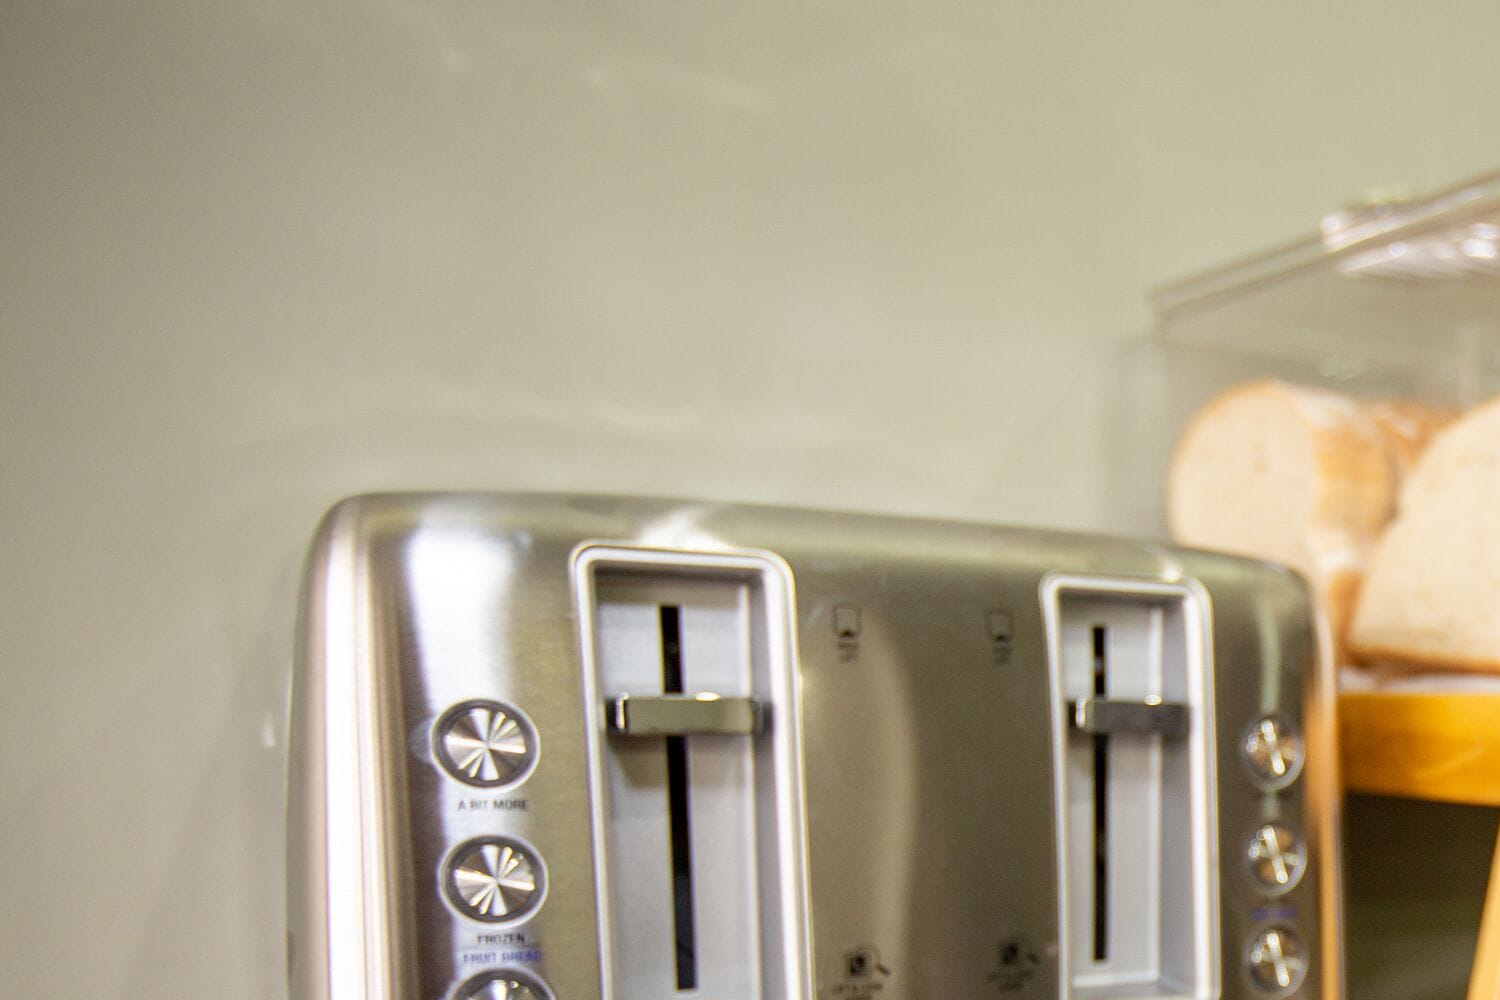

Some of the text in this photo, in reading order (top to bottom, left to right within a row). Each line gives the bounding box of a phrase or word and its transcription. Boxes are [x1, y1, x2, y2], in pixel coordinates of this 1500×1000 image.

[458, 799, 528, 811] A BIT MORE
[476, 932, 526, 945] FROZEN
